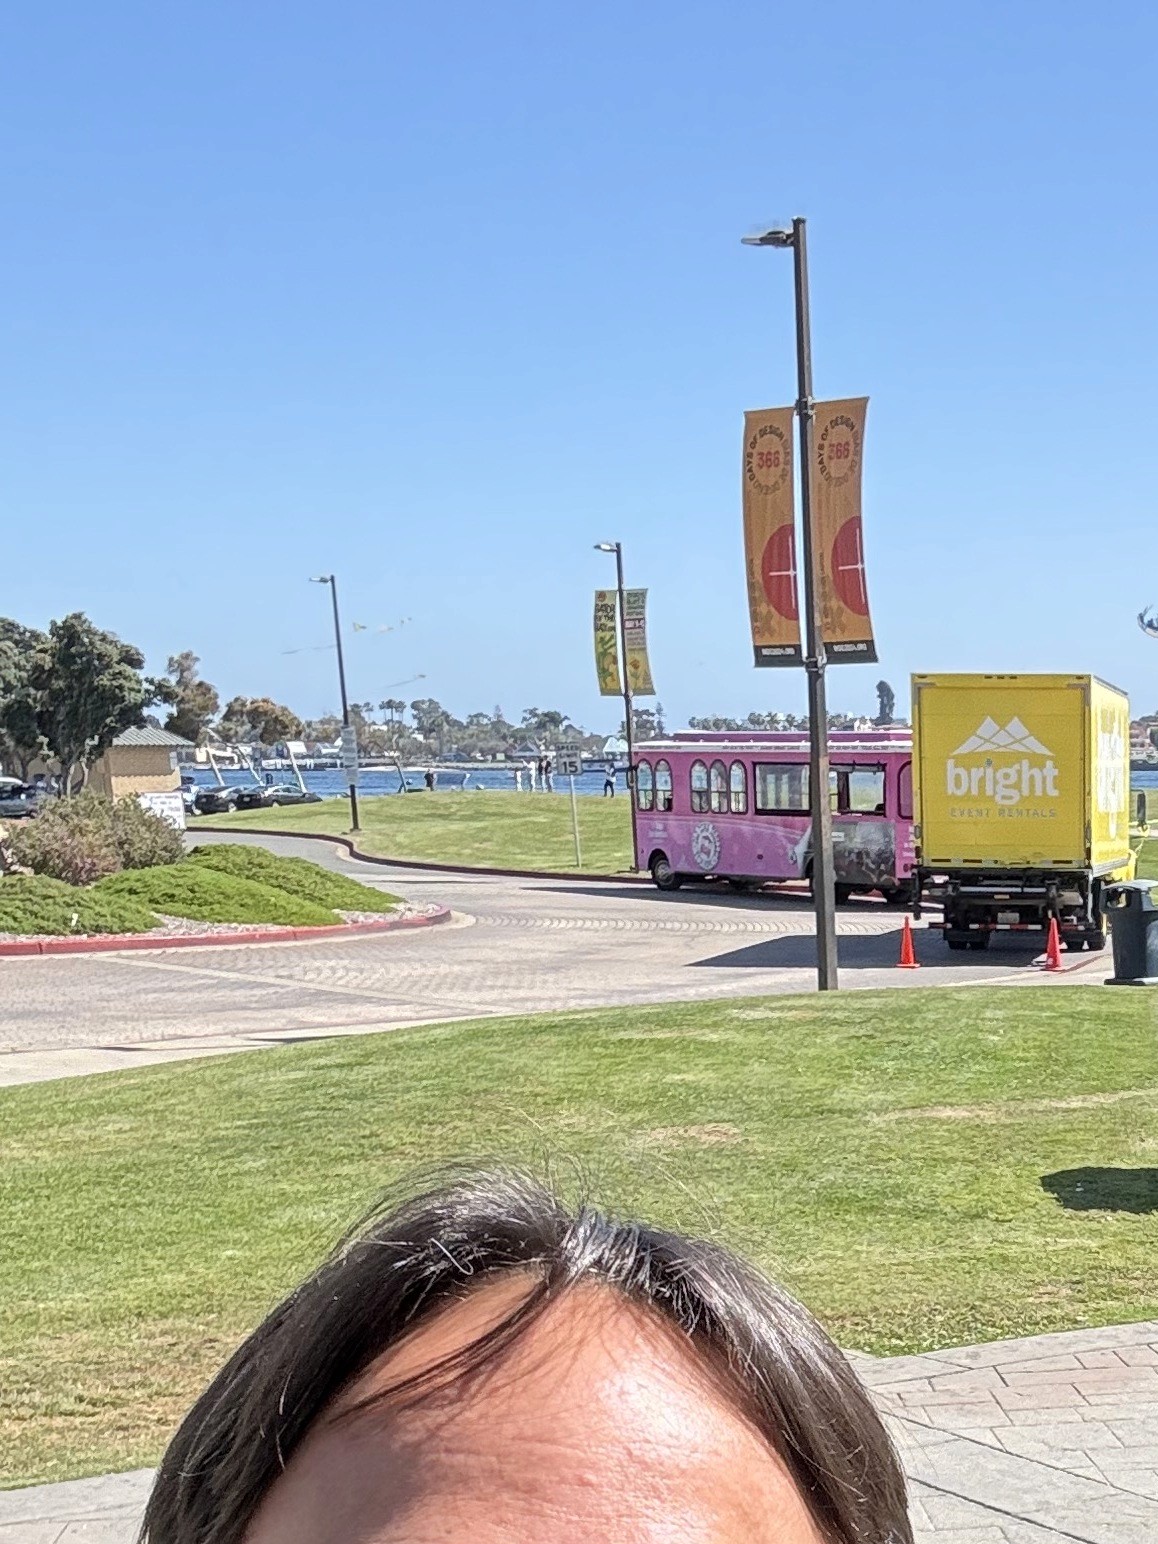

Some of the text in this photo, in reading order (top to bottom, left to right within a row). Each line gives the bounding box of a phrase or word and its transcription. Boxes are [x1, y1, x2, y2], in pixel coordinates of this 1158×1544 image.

[757, 449, 781, 469] 366
[828, 440, 851, 460] 366
[561, 761, 578, 773] 15
[946, 758, 1060, 805] bright
[950, 807, 1056, 818] EVENT RENTALS
